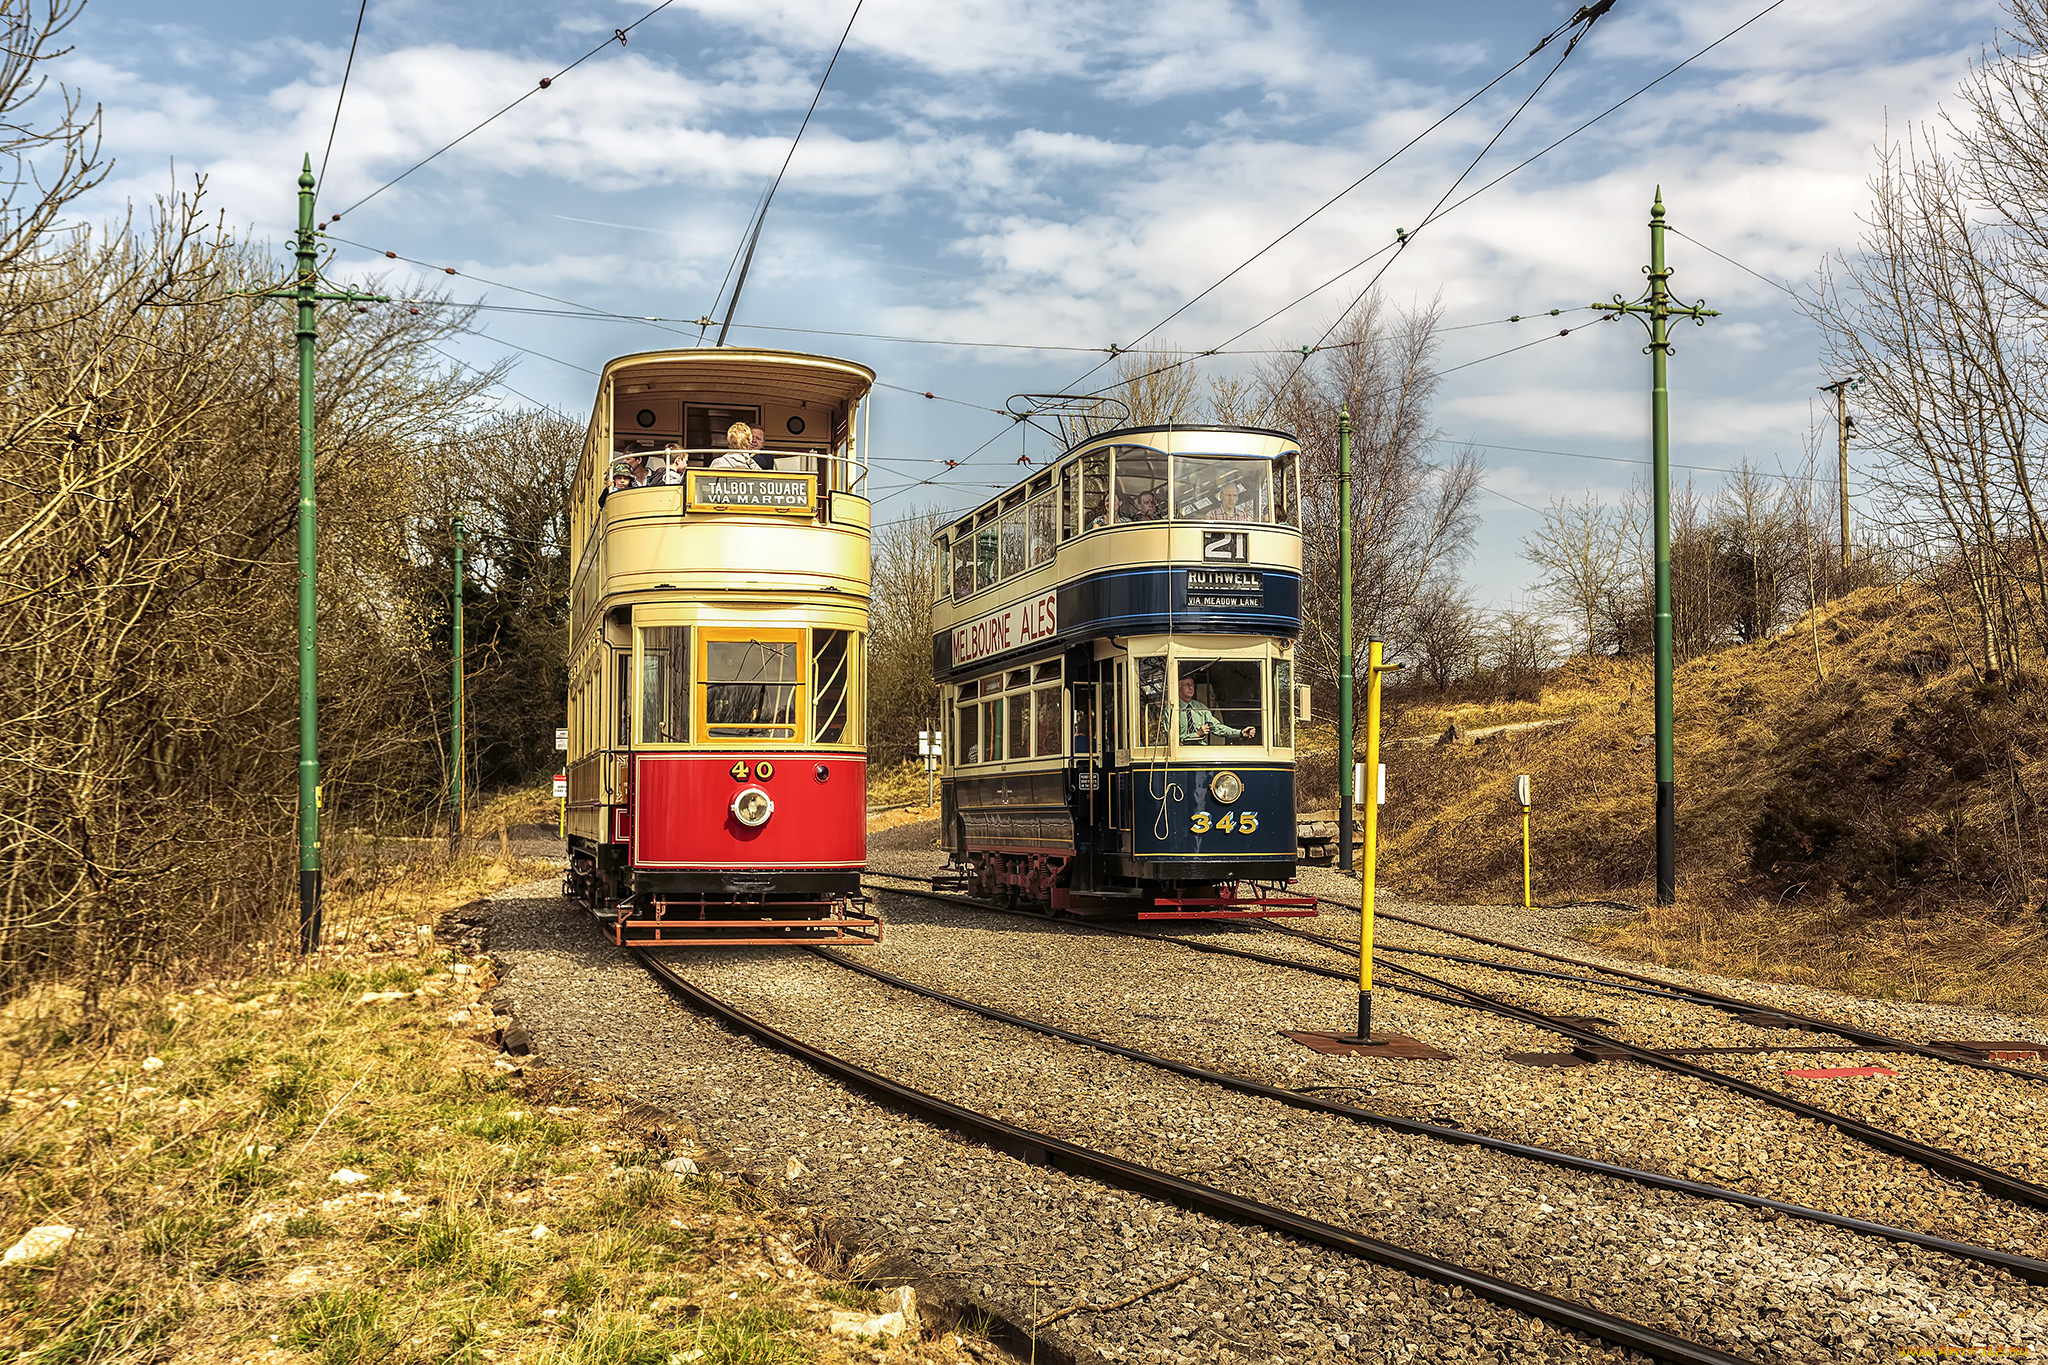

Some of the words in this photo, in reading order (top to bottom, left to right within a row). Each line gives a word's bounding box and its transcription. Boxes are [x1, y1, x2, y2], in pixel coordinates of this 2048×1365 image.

[708, 482, 754, 495] TALBOT
[759, 482, 807, 496] SQUARE
[708, 495, 731, 504] VIA
[737, 495, 808, 505] MARTON
[1204, 532, 1245, 559] 21
[1188, 596, 1201, 605] VIA
[1204, 596, 1238, 606] MEADOW
[1240, 598, 1259, 606] LANE
[952, 612, 1011, 665] MELBOURNE
[1020, 595, 1056, 643] ALES
[730, 760, 775, 781] 40
[1190, 811, 1259, 834] 345
